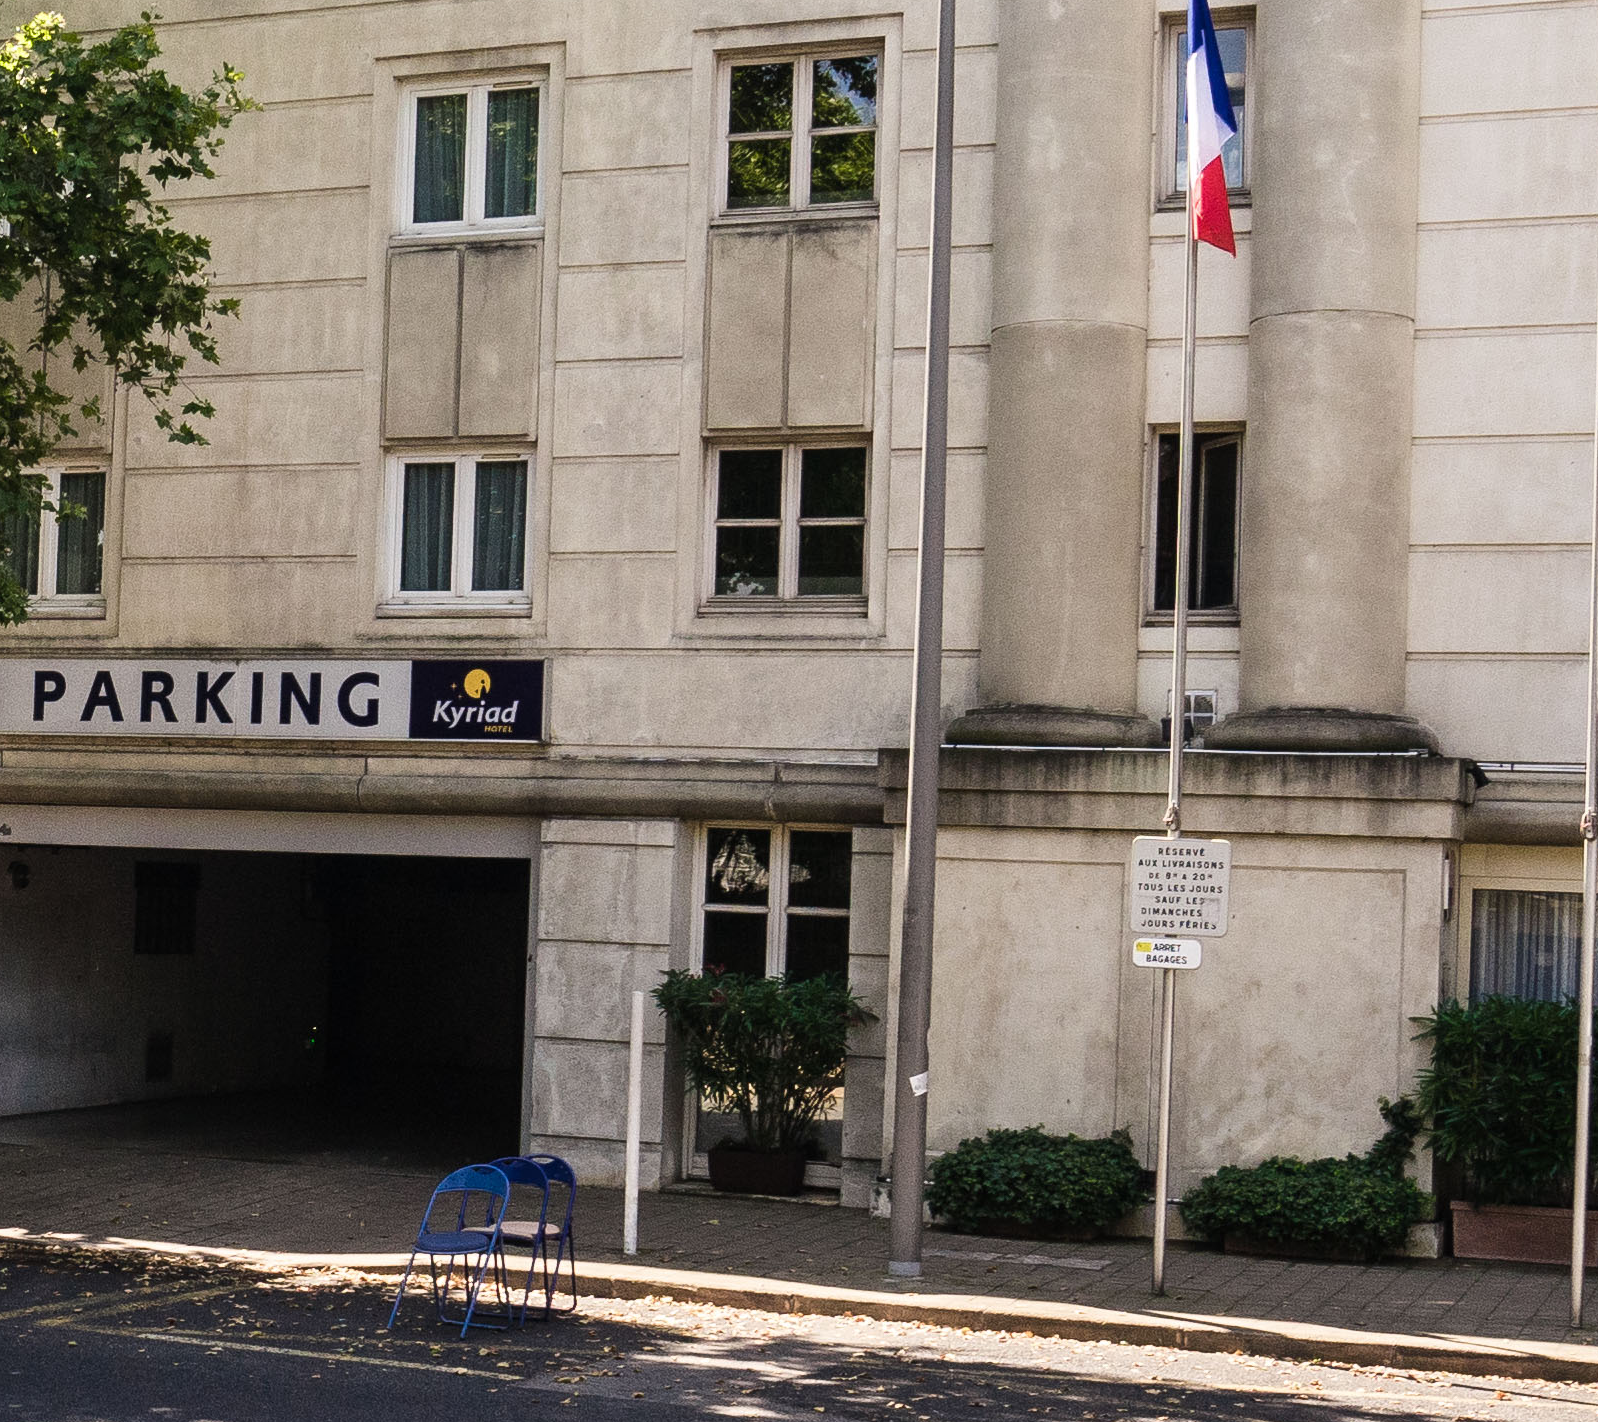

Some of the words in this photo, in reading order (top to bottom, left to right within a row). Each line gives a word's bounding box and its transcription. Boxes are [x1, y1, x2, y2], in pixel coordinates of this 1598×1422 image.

[32, 669, 380, 728] PARKING
[432, 699, 519, 729] Kyriad
[484, 725, 513, 733] HOTEL
[1158, 847, 1205, 857] RÉSERVÉ
[1138, 859, 1158, 867] AUX
[1162, 860, 1224, 870] LIVRAISONS
[1138, 883, 1163, 892] TOUS
[1167, 884, 1186, 892] LES
[1189, 885, 1223, 894] JOURS
[1155, 896, 1181, 904] SAUF
[1186, 897, 1205, 905] LES
[1141, 907, 1203, 917] DIMANCHES
[1141, 920, 1175, 928] JOURS
[1152, 943, 1182, 952] ARRET
[1145, 954, 1187, 965] BAGAGES
